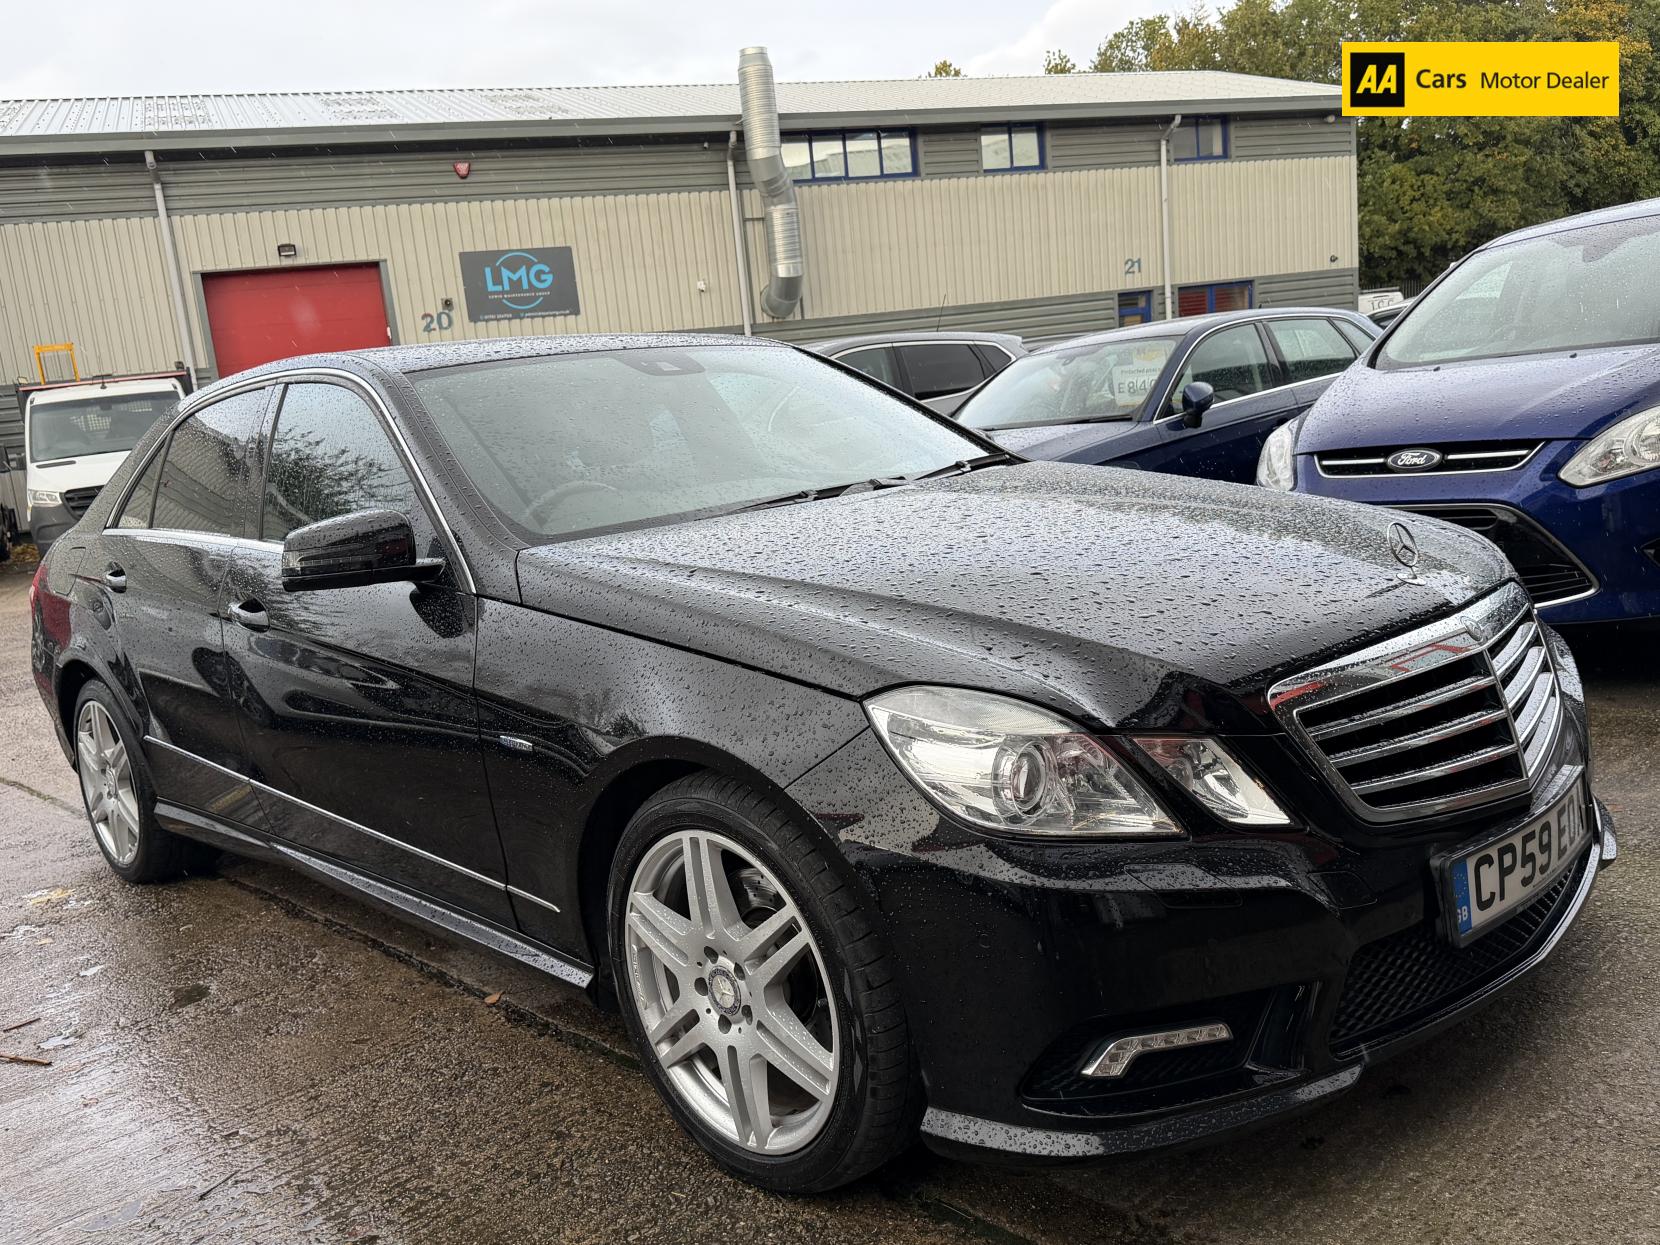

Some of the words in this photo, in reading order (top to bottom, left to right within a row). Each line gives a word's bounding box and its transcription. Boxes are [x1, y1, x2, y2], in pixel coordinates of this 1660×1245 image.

[1124, 257, 1142, 274] 21
[484, 263, 554, 292] LMG
[421, 310, 454, 333] 20
[1397, 452, 1428, 466] Ford
[1474, 820, 1551, 912] CP59
